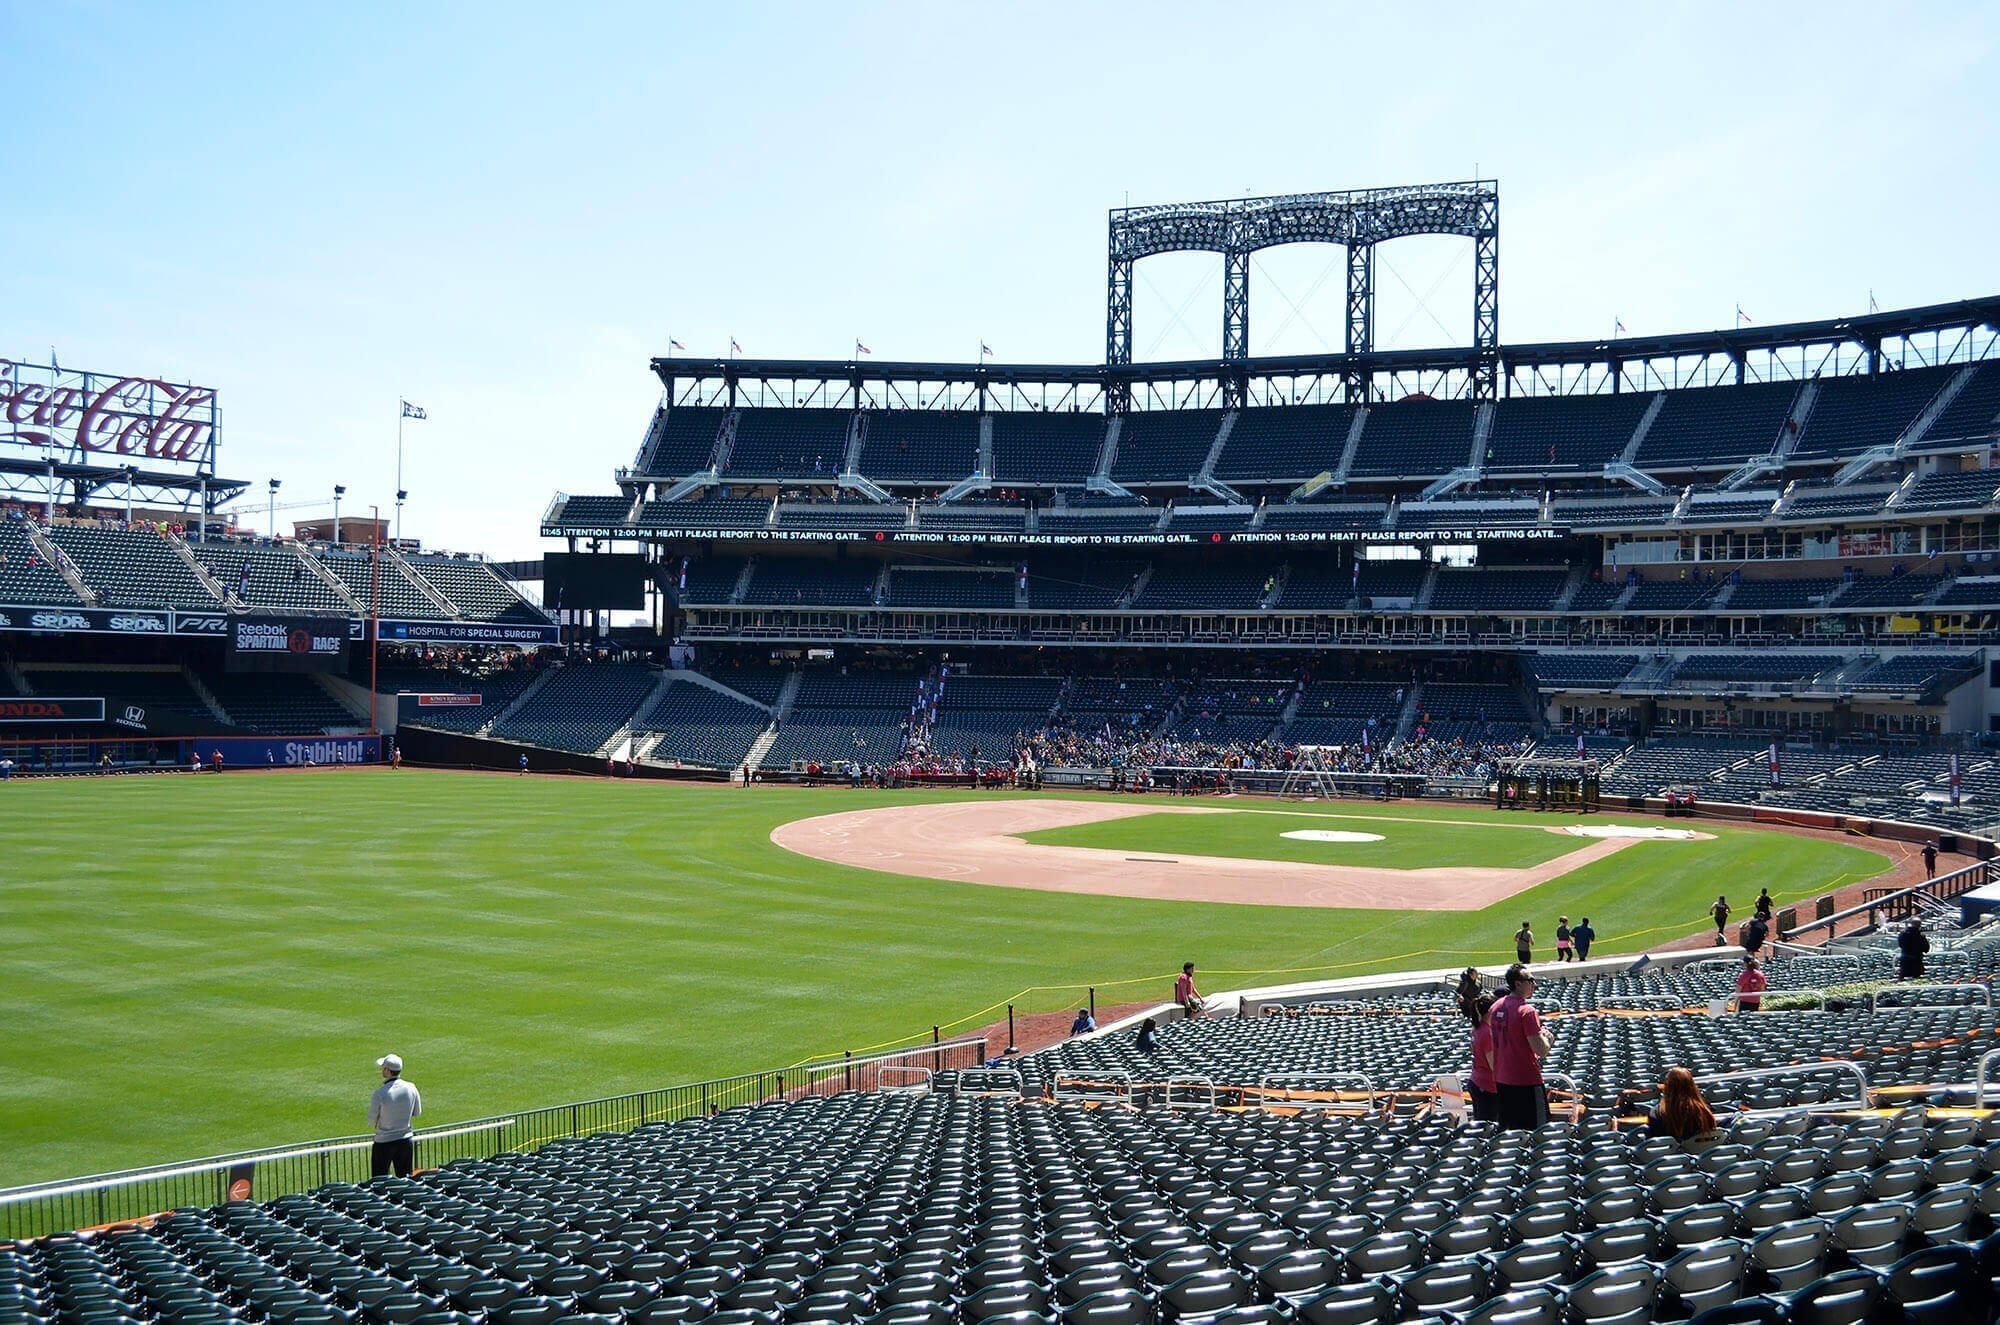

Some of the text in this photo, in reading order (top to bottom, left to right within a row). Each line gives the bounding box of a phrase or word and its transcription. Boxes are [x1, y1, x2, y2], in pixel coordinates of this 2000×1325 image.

[542, 528, 561, 536] 11:45
[613, 528, 636, 536] 12:00
[638, 529, 653, 537] PM
[685, 530, 718, 538] PLEASE
[720, 530, 753, 538] REPORT
[790, 532, 833, 540] STARTING
[1230, 534, 1282, 542] ATTENTION
[1361, 532, 1396, 540] PLEASE
[1398, 532, 1435, 540] REPORT
[1454, 531, 1472, 539] THE
[1476, 530, 1524, 538] STARTING
[947, 534, 970, 542] 12:00
[1122, 535, 1164, 543] STARTING
[238, 623, 288, 635] Reebok
[409, 626, 542, 638] HOSPITAL FOR SPECIAL SURGERY
[237, 635, 341, 650] SPARTAN RACE
[116, 718, 148, 730] HONDA
